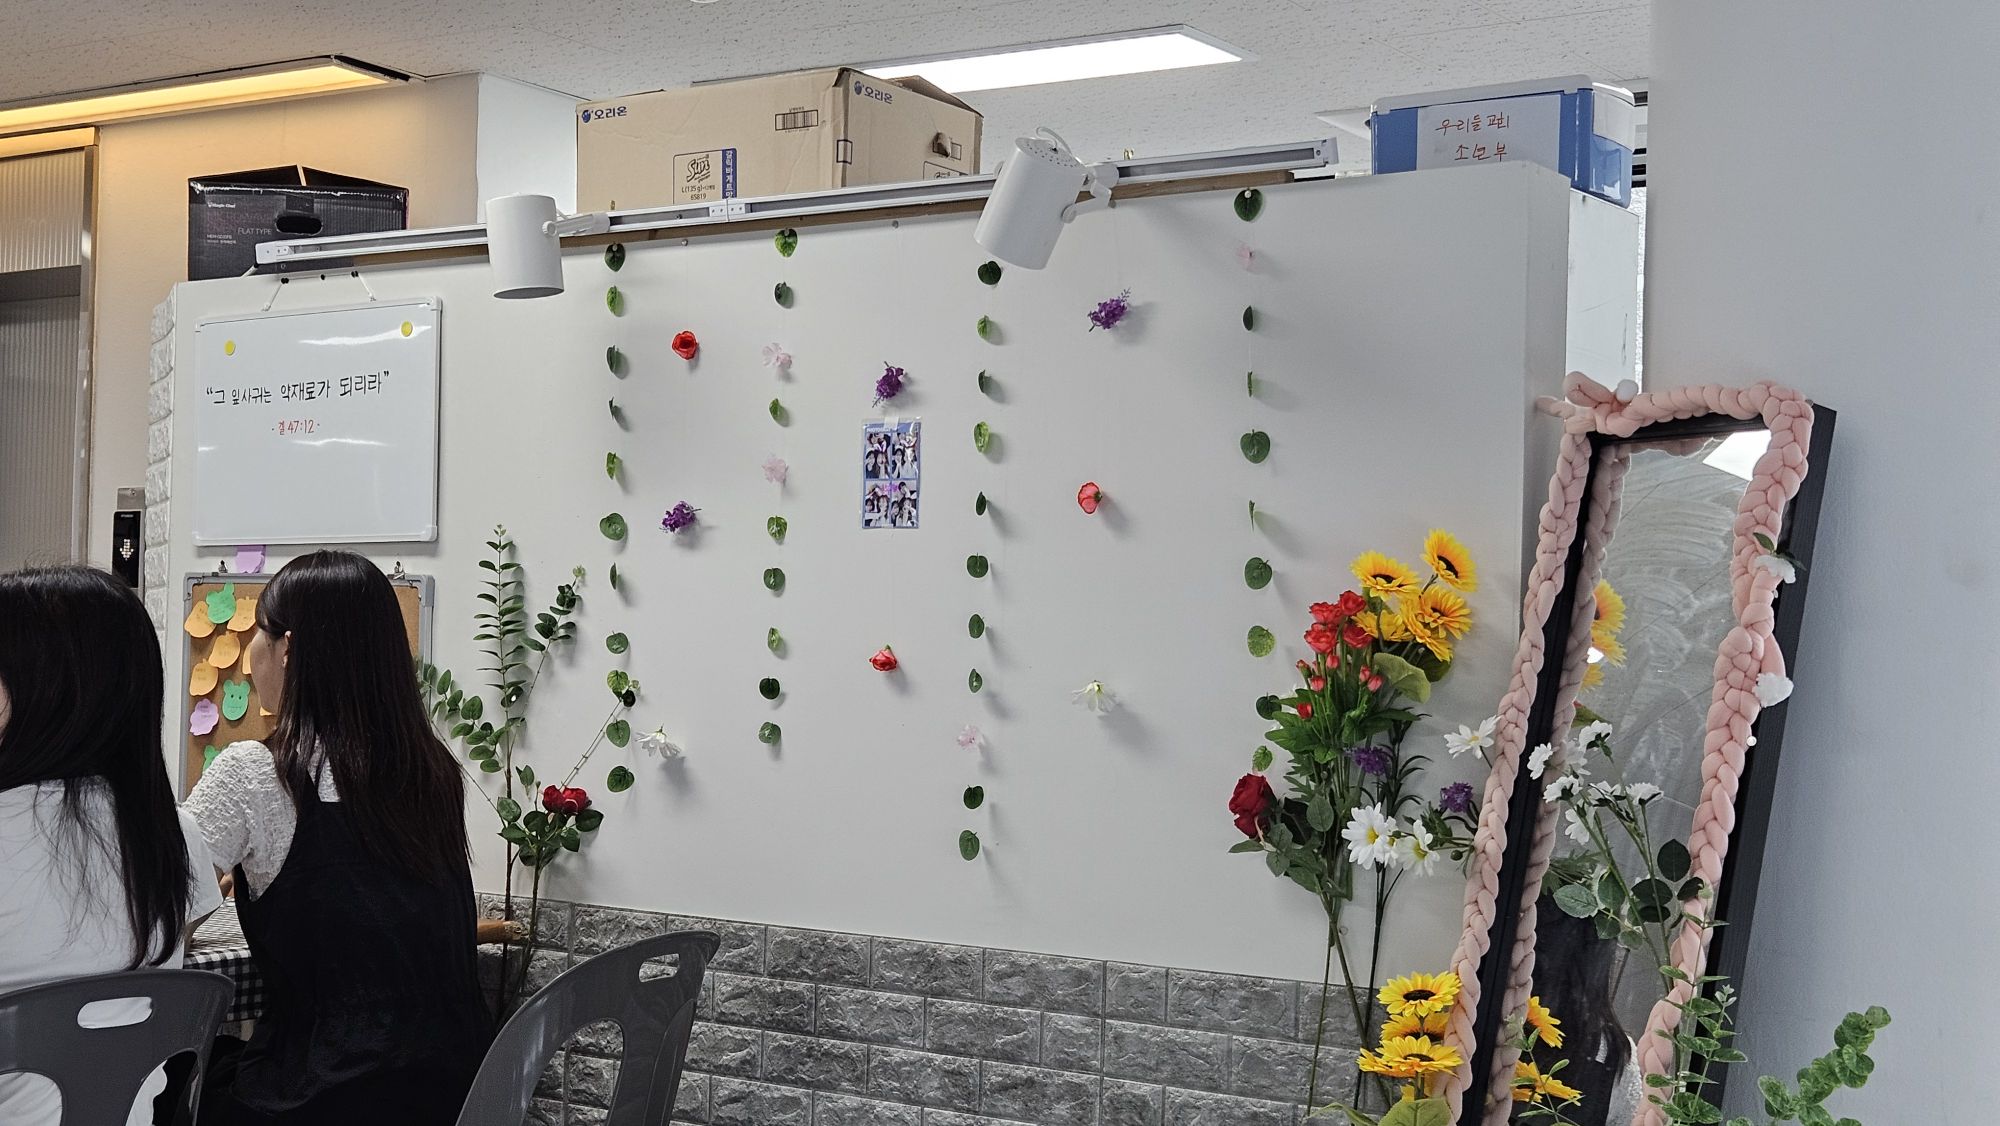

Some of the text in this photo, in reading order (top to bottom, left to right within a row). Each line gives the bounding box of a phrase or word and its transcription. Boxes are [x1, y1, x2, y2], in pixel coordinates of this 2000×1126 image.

[864, 86, 892, 104] 오리온
[594, 106, 627, 120] 오리온
[1435, 112, 1510, 136] 우리들 교회
[686, 158, 710, 183] Sun
[237, 226, 272, 236] FLAT TYPE
[231, 386, 272, 406] 잎사귀는
[280, 379, 331, 402] 약재료가
